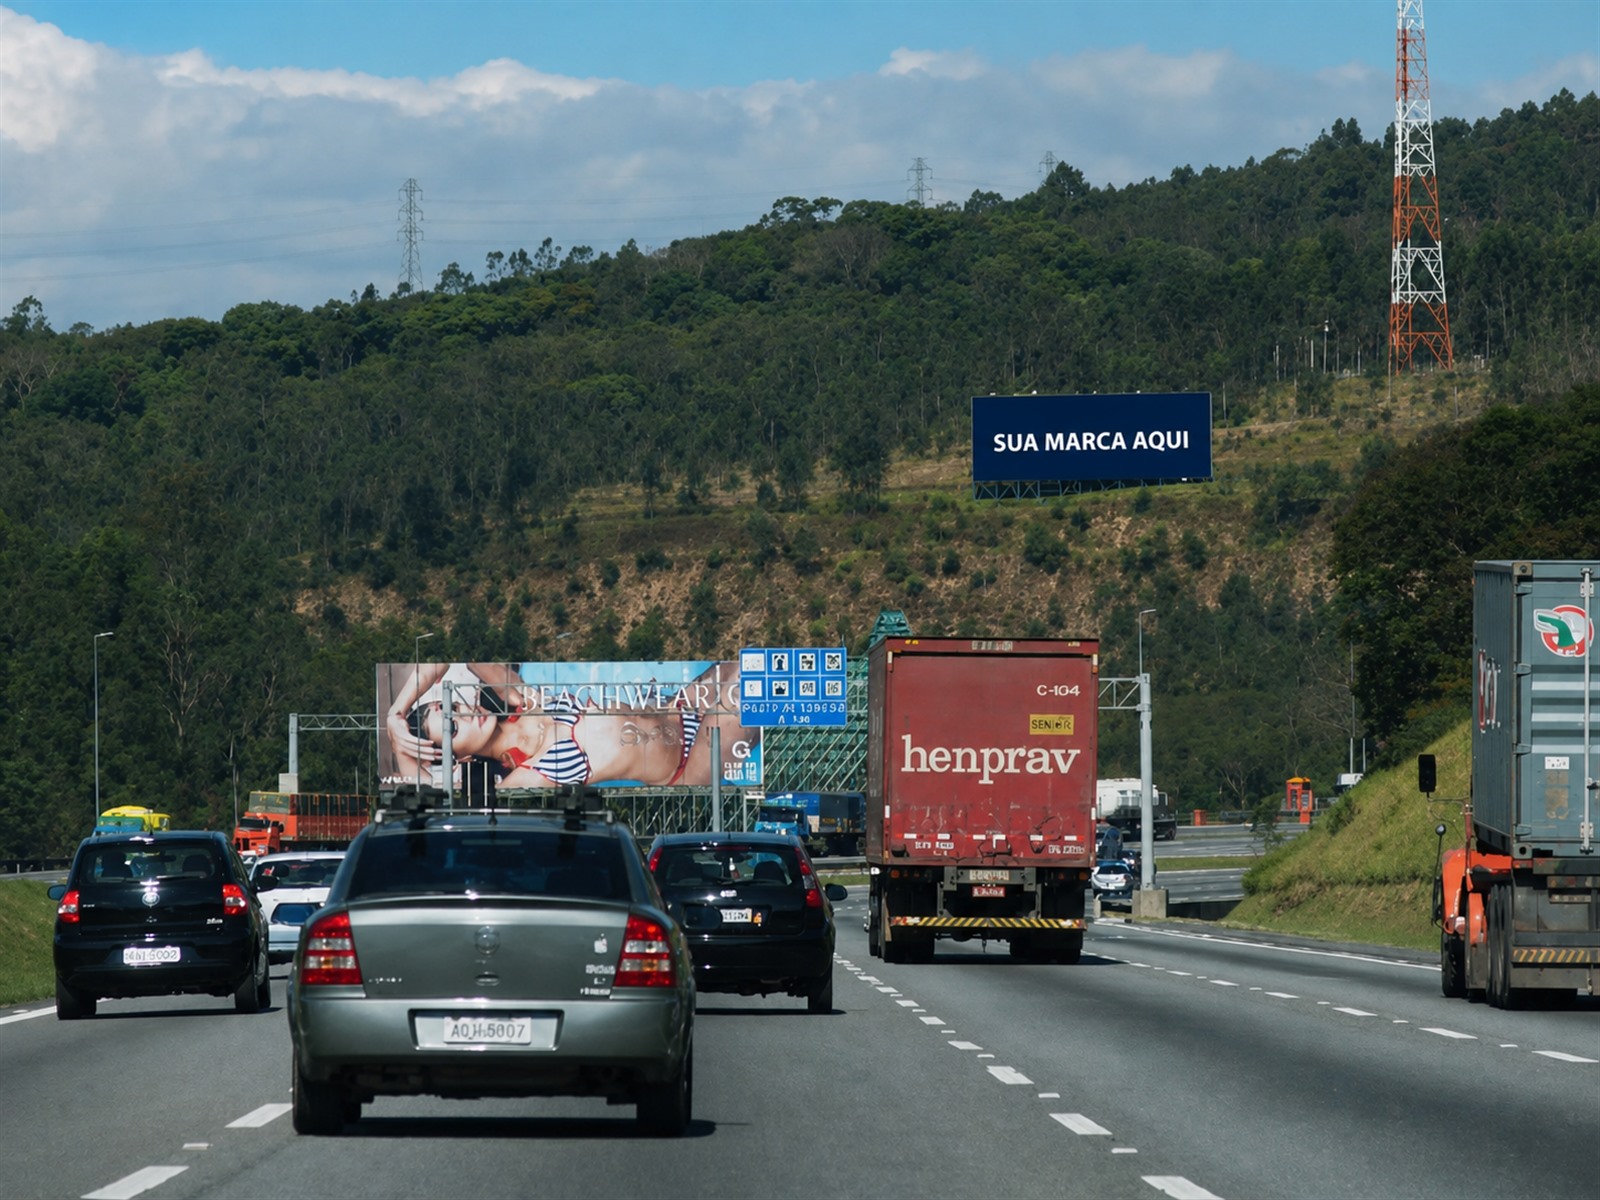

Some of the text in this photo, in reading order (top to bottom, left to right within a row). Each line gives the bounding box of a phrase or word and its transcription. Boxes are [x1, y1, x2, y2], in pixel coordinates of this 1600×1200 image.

[993, 430, 1189, 452] SUA MARCA AQUI
[523, 684, 709, 712] BEACHWEAR
[1036, 684, 1081, 697] C-104
[901, 734, 1081, 785] henprav
